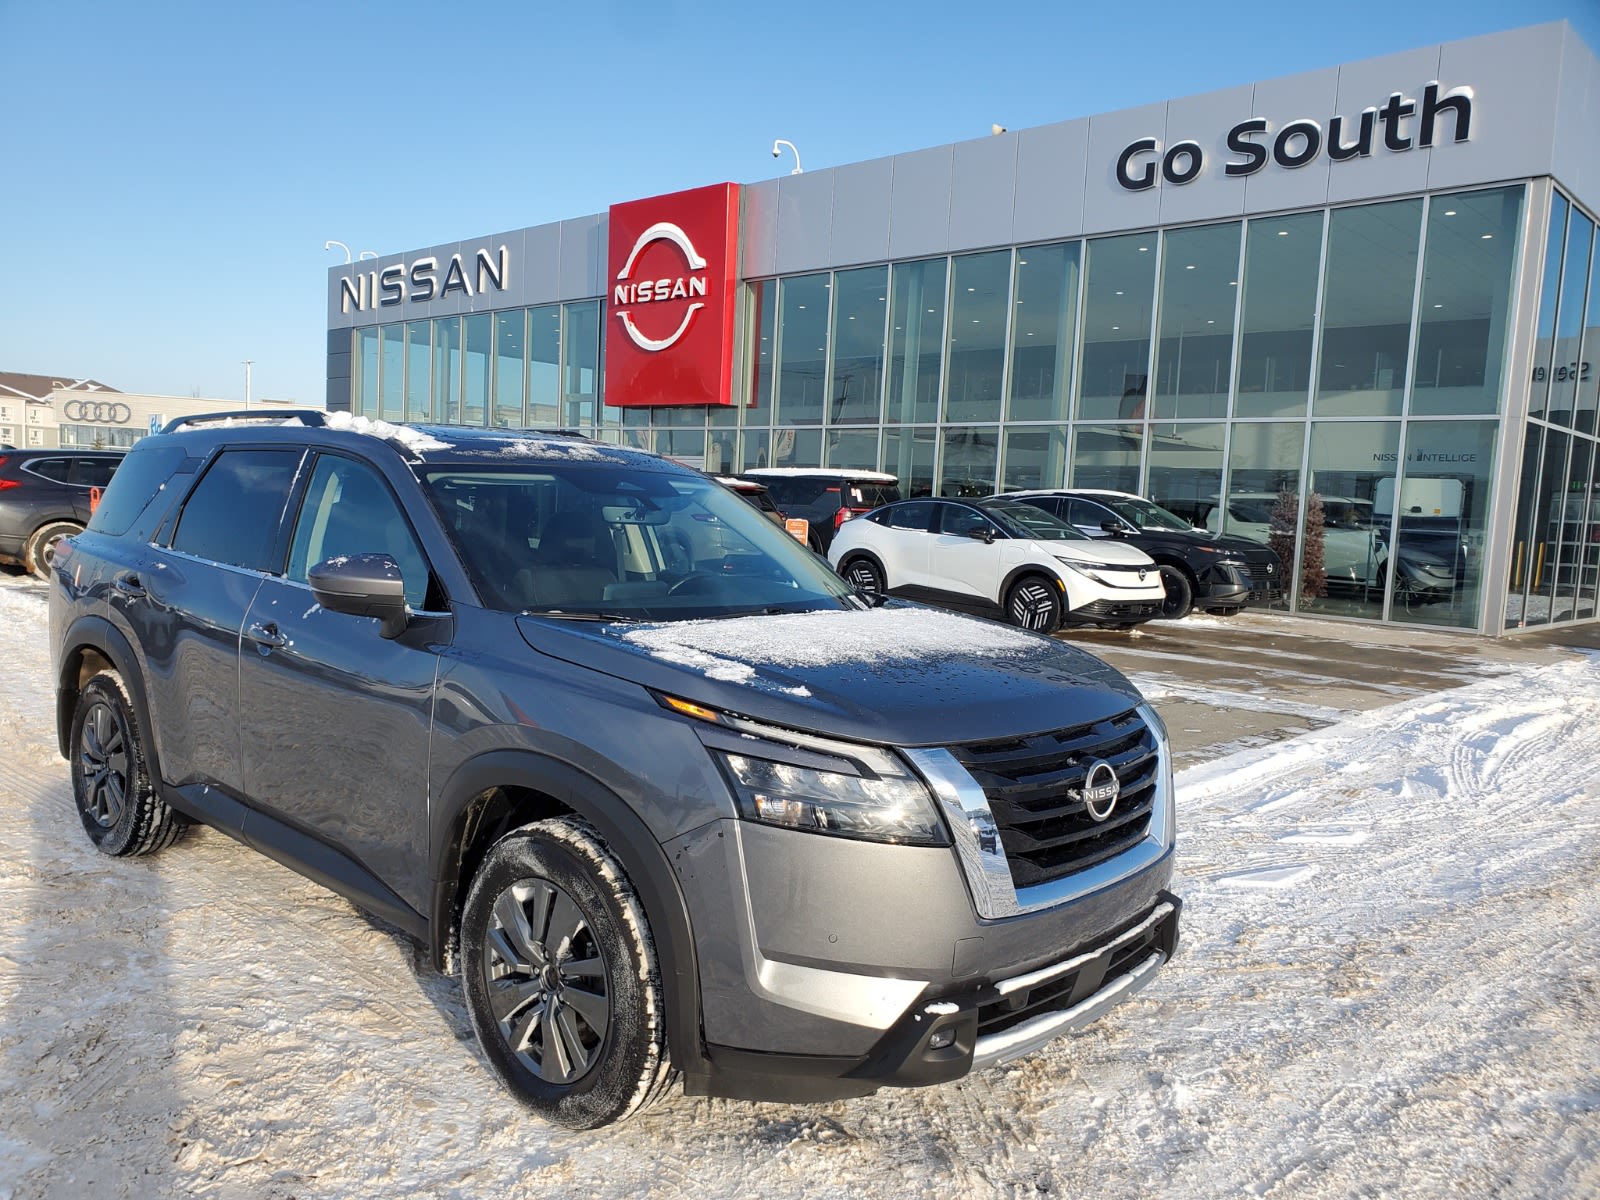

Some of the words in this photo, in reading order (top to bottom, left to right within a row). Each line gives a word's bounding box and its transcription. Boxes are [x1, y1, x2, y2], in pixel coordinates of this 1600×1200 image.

[1115, 138, 1205, 192] Go
[1224, 80, 1474, 178] South
[340, 245, 508, 314] NISSAN
[614, 276, 706, 305] NISSAN
[1373, 453, 1412, 462] NISSN
[1085, 783, 1120, 800] NISSAN
